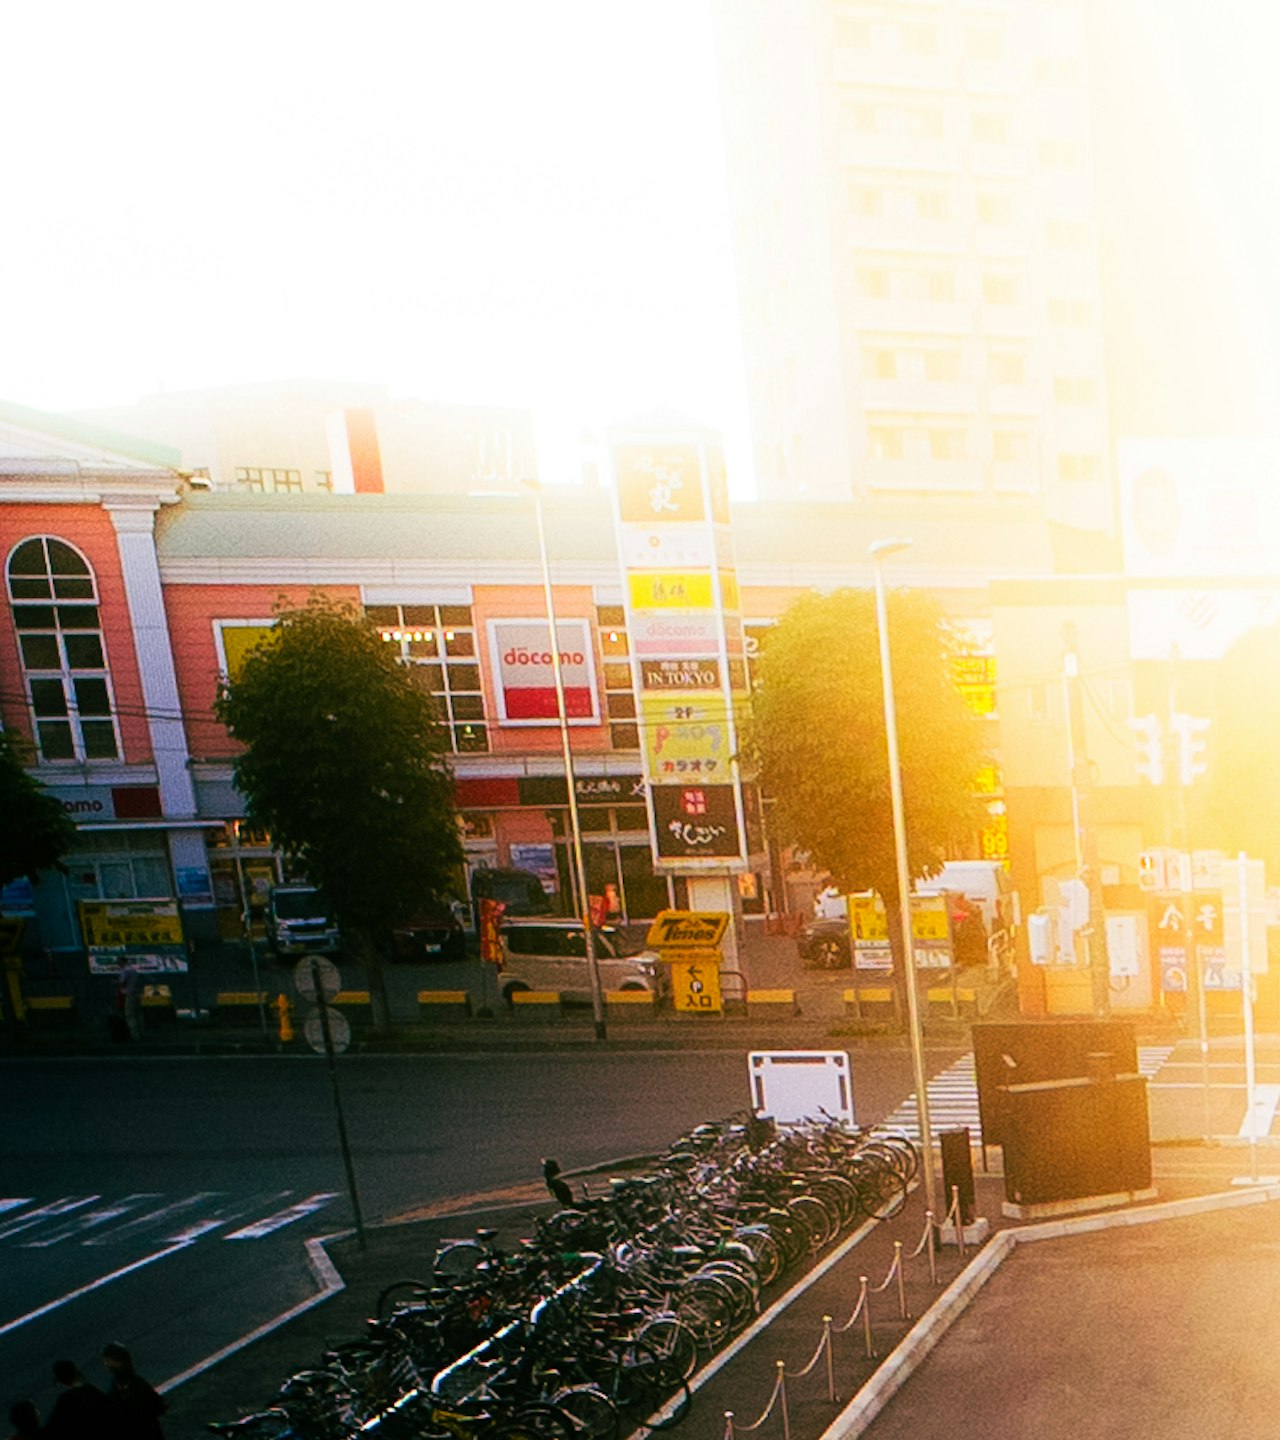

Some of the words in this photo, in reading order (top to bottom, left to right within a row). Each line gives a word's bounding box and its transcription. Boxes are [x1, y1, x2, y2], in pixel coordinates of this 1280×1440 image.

[504, 647, 584, 665] docomo
[648, 672, 664, 685] IN
[666, 671, 715, 685] TOKYO
[674, 706, 693, 719] 2F
[662, 760, 717, 772] カラオケ
[661, 918, 721, 942] Times
[686, 994, 712, 1008] 入口
